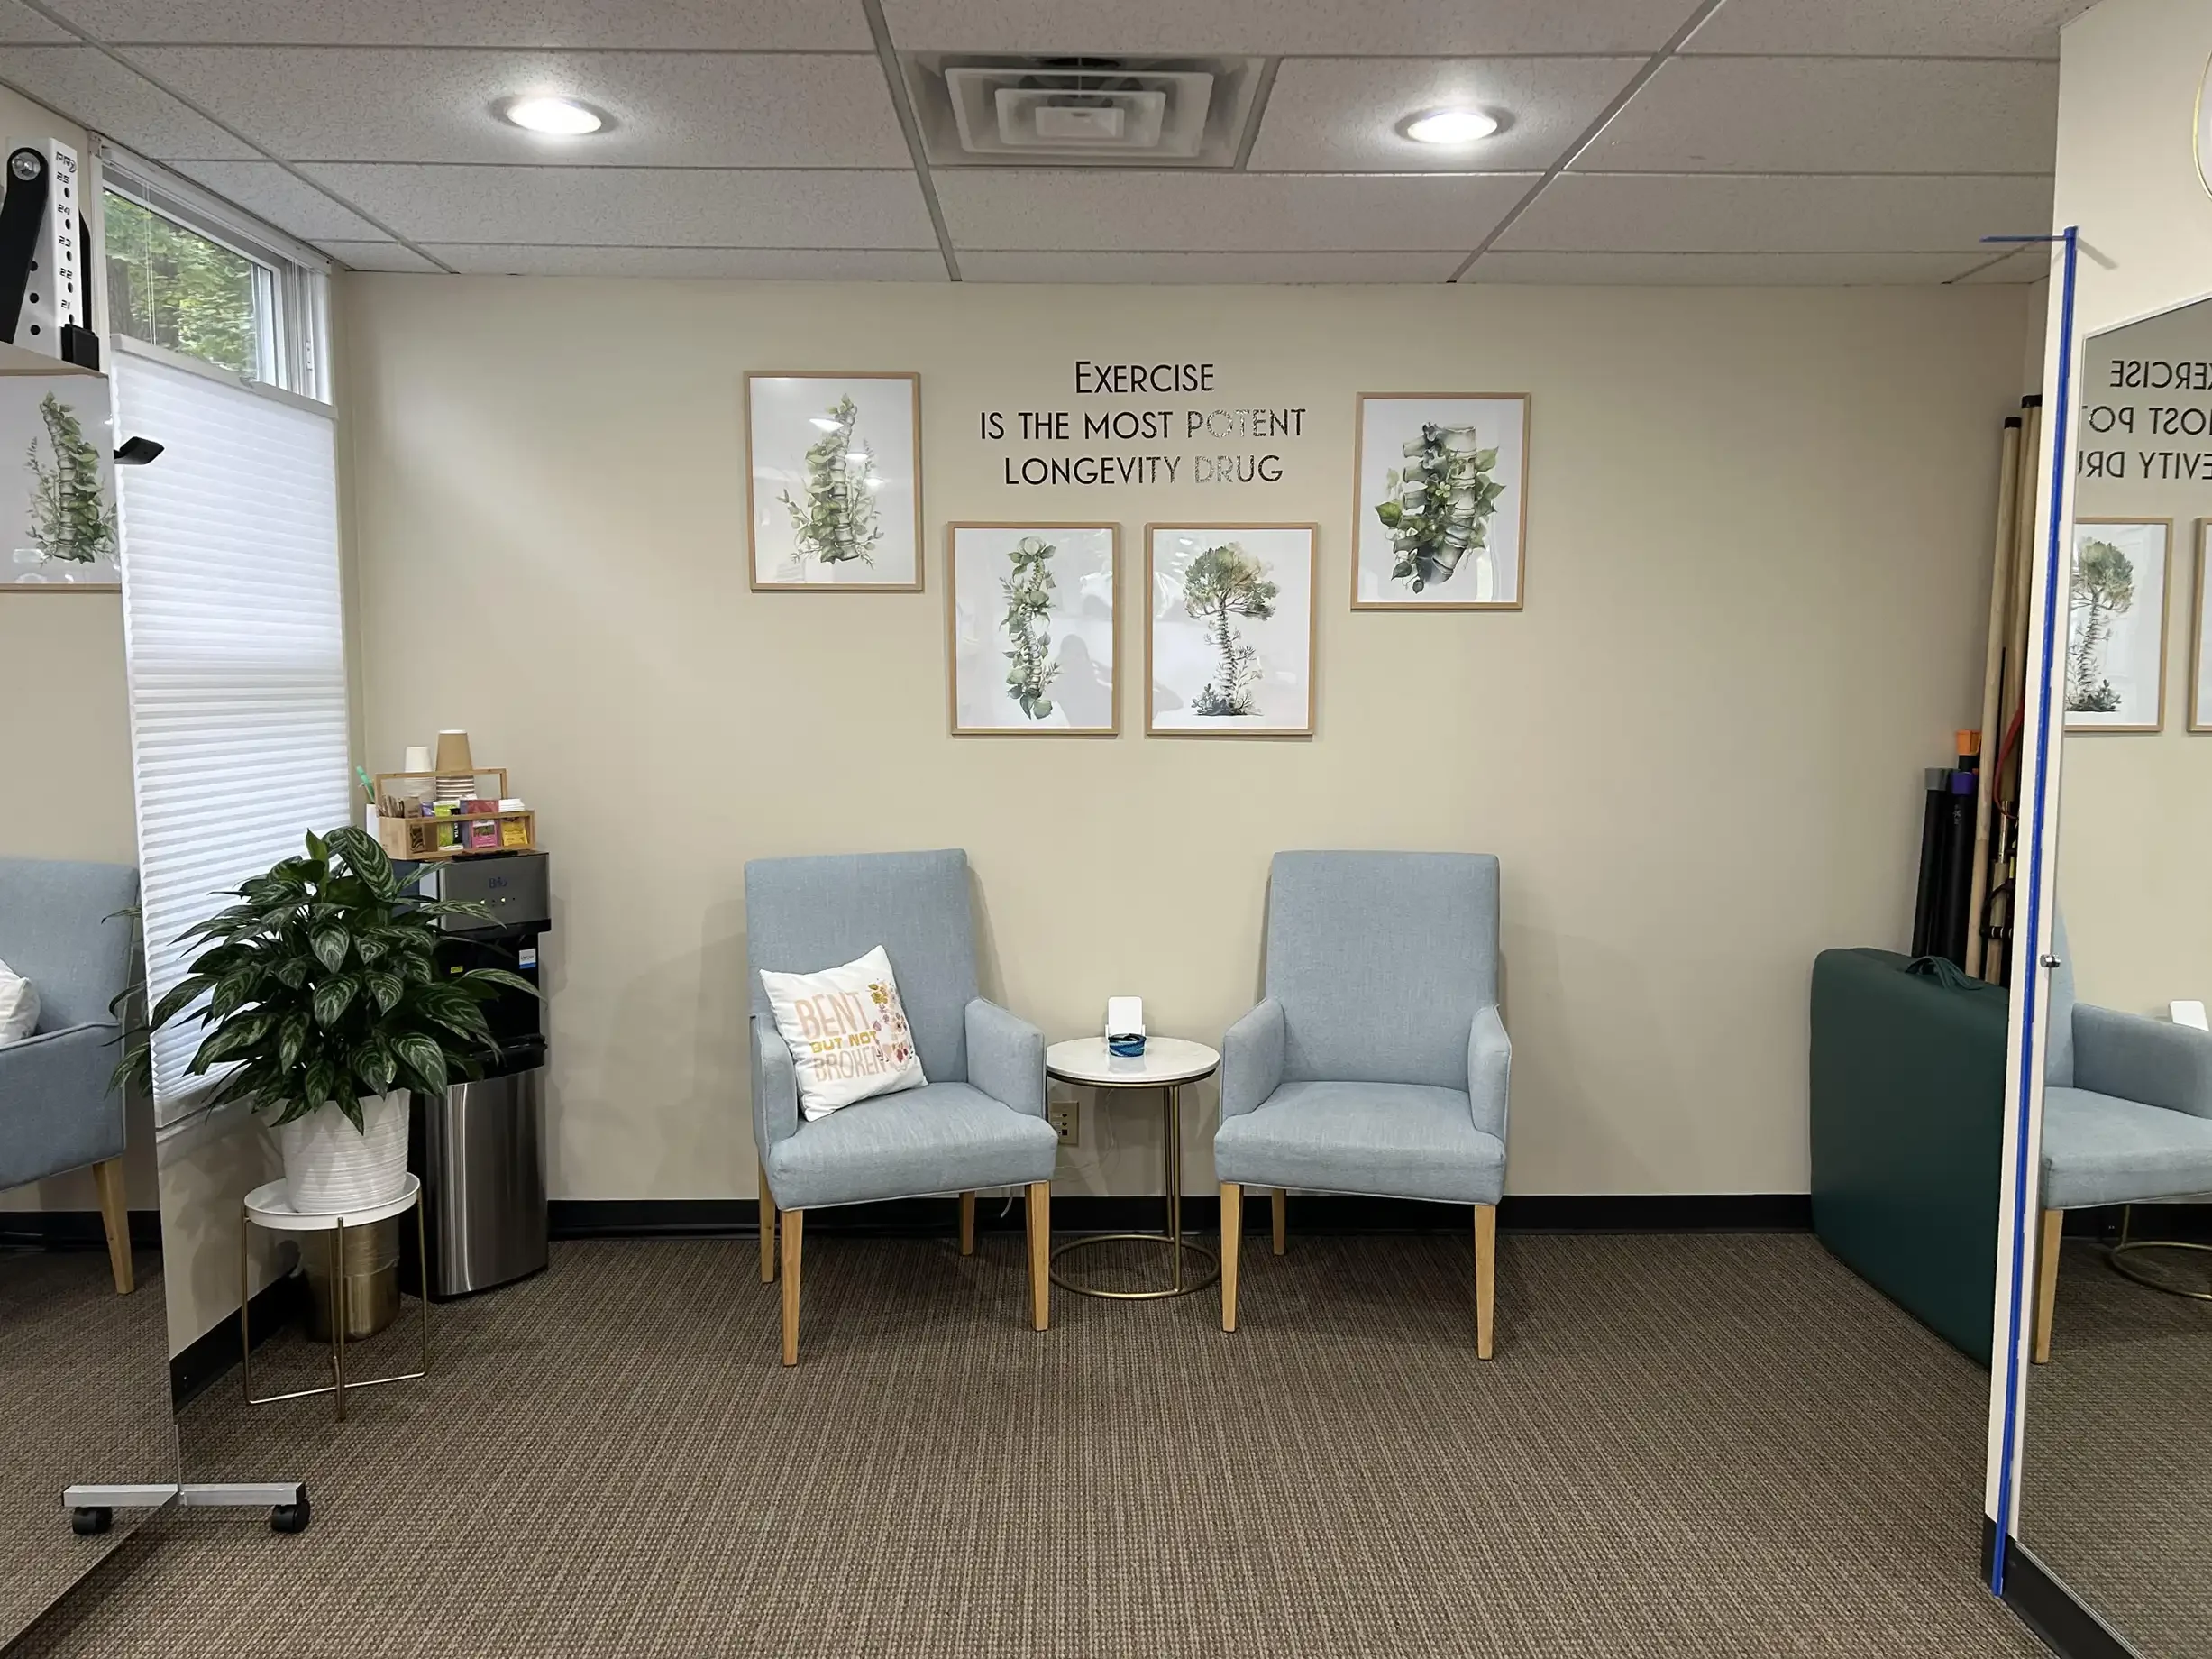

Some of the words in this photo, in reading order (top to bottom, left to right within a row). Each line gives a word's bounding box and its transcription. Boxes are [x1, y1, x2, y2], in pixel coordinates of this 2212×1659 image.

[57, 171, 69, 184] 25
[58, 204, 71, 216] 24
[59, 235, 72, 248] 23
[59, 267, 73, 280] 22
[60, 299, 71, 311] 21
[1074, 360, 1215, 394] EXERCISE
[980, 411, 1005, 440] IS
[1018, 411, 1070, 440] THE
[1084, 411, 1174, 440] MOST
[1186, 408, 1307, 439] POTENT
[1004, 455, 1182, 486] LONGEVITY
[1194, 454, 1284, 484] DRUG
[794, 991, 871, 1040] BENT
[810, 1038, 843, 1054] BUT
[848, 1031, 877, 1047] NOT
[812, 1045, 888, 1083] BROKEN
